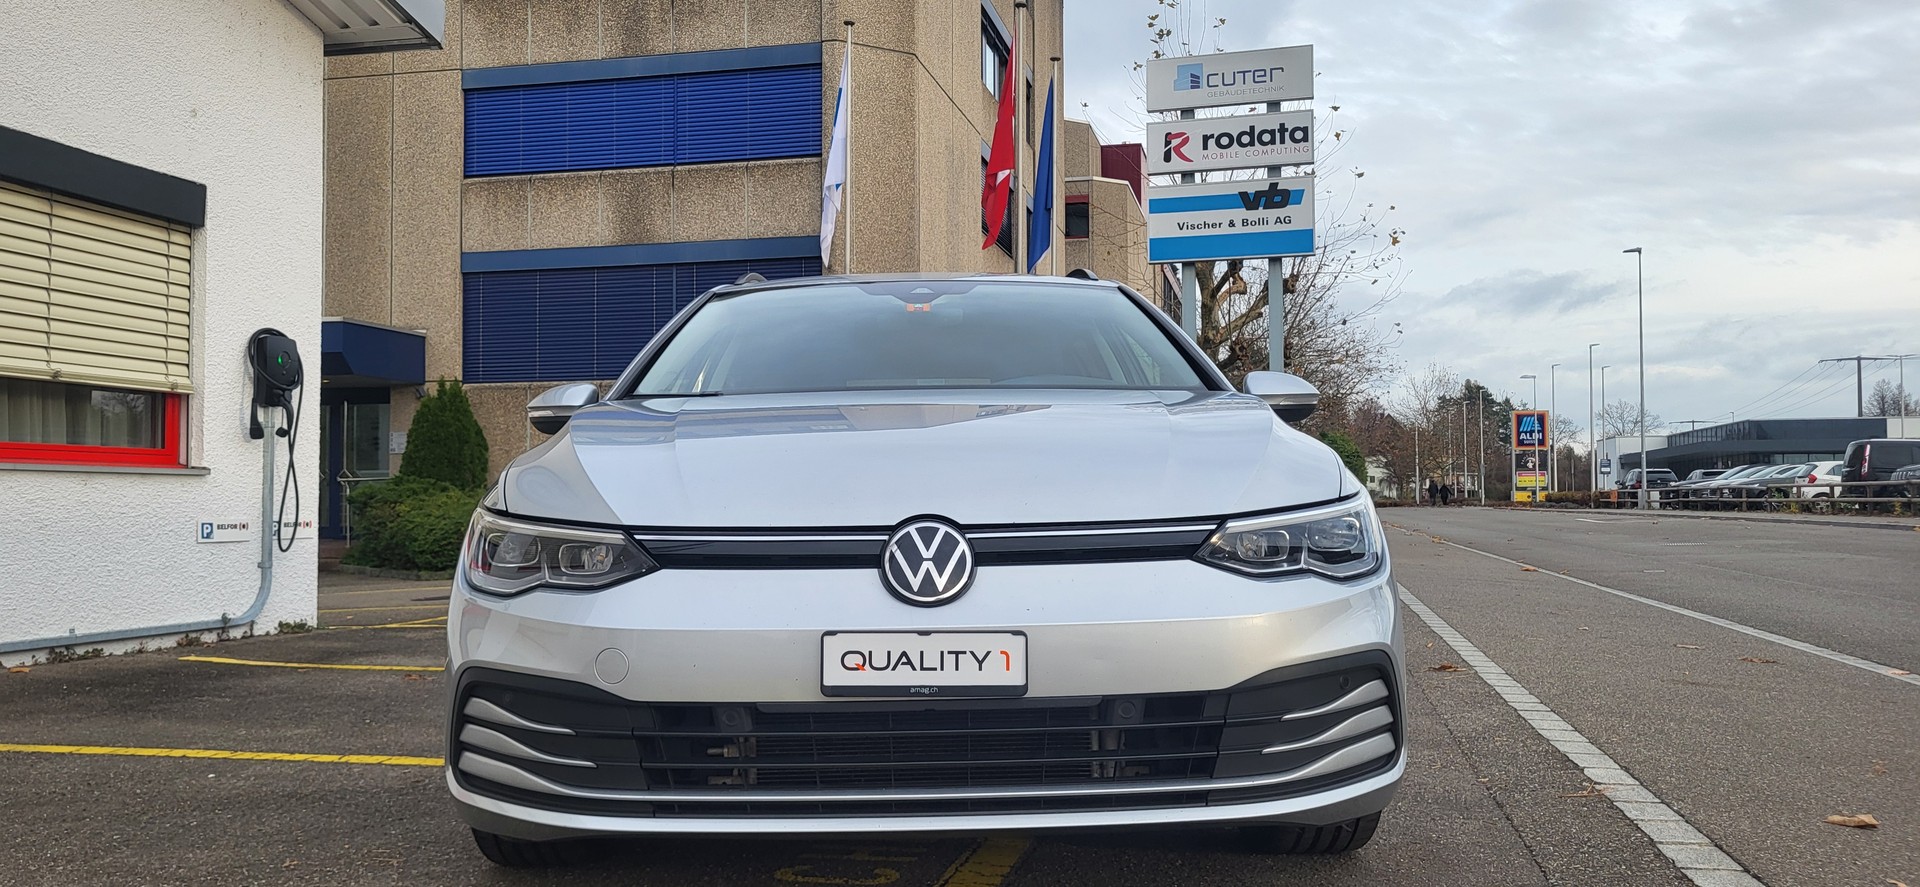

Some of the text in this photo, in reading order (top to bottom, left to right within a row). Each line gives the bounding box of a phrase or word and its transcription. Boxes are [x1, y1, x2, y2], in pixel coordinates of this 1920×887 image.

[1207, 85, 1285, 98] GEBÄUDETECHNIK
[1202, 123, 1309, 150] rodata
[1202, 145, 1310, 161] MOBILE COMPUTING
[1238, 182, 1291, 211] vb
[1177, 215, 1292, 231] Vischer & Bolli AG
[203, 524, 212, 538] P
[886, 523, 970, 597] VW
[840, 650, 1010, 672] QUALITY 1
[909, 686, 939, 695] amag.ch
